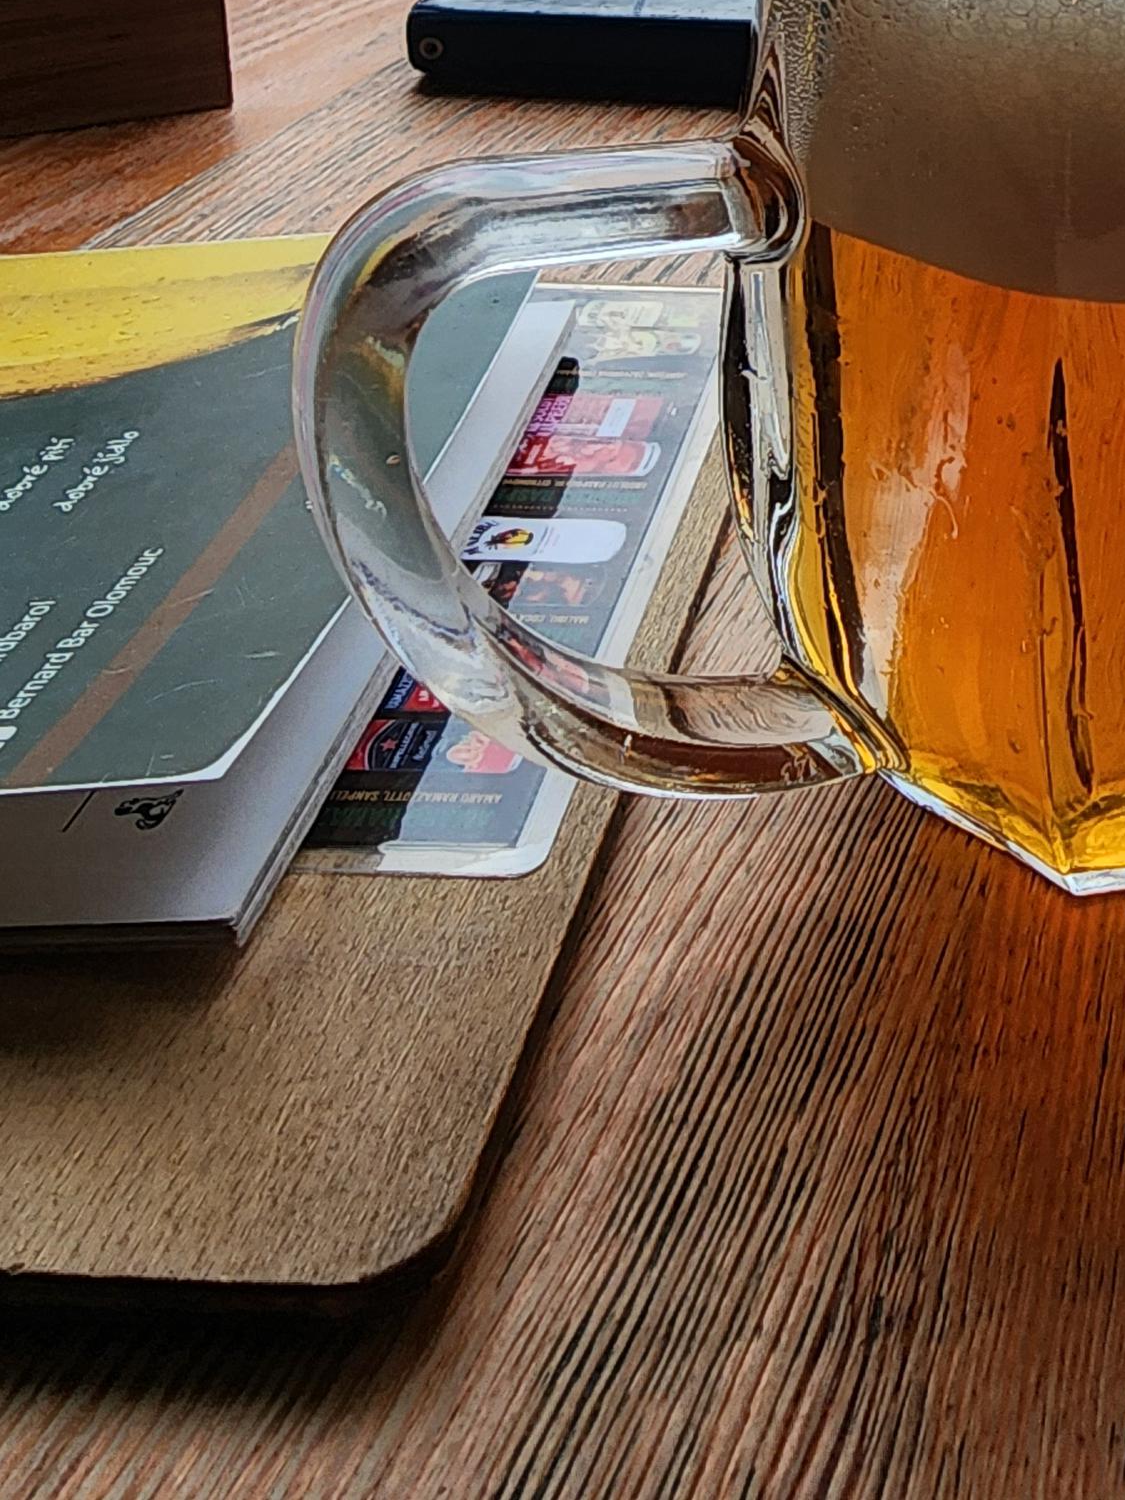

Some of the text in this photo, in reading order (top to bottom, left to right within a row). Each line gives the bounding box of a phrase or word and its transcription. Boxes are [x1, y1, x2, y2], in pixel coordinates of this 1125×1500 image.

[52, 465, 109, 512] dobré
[0, 548, 164, 720] Bernard Bar Olomouc
